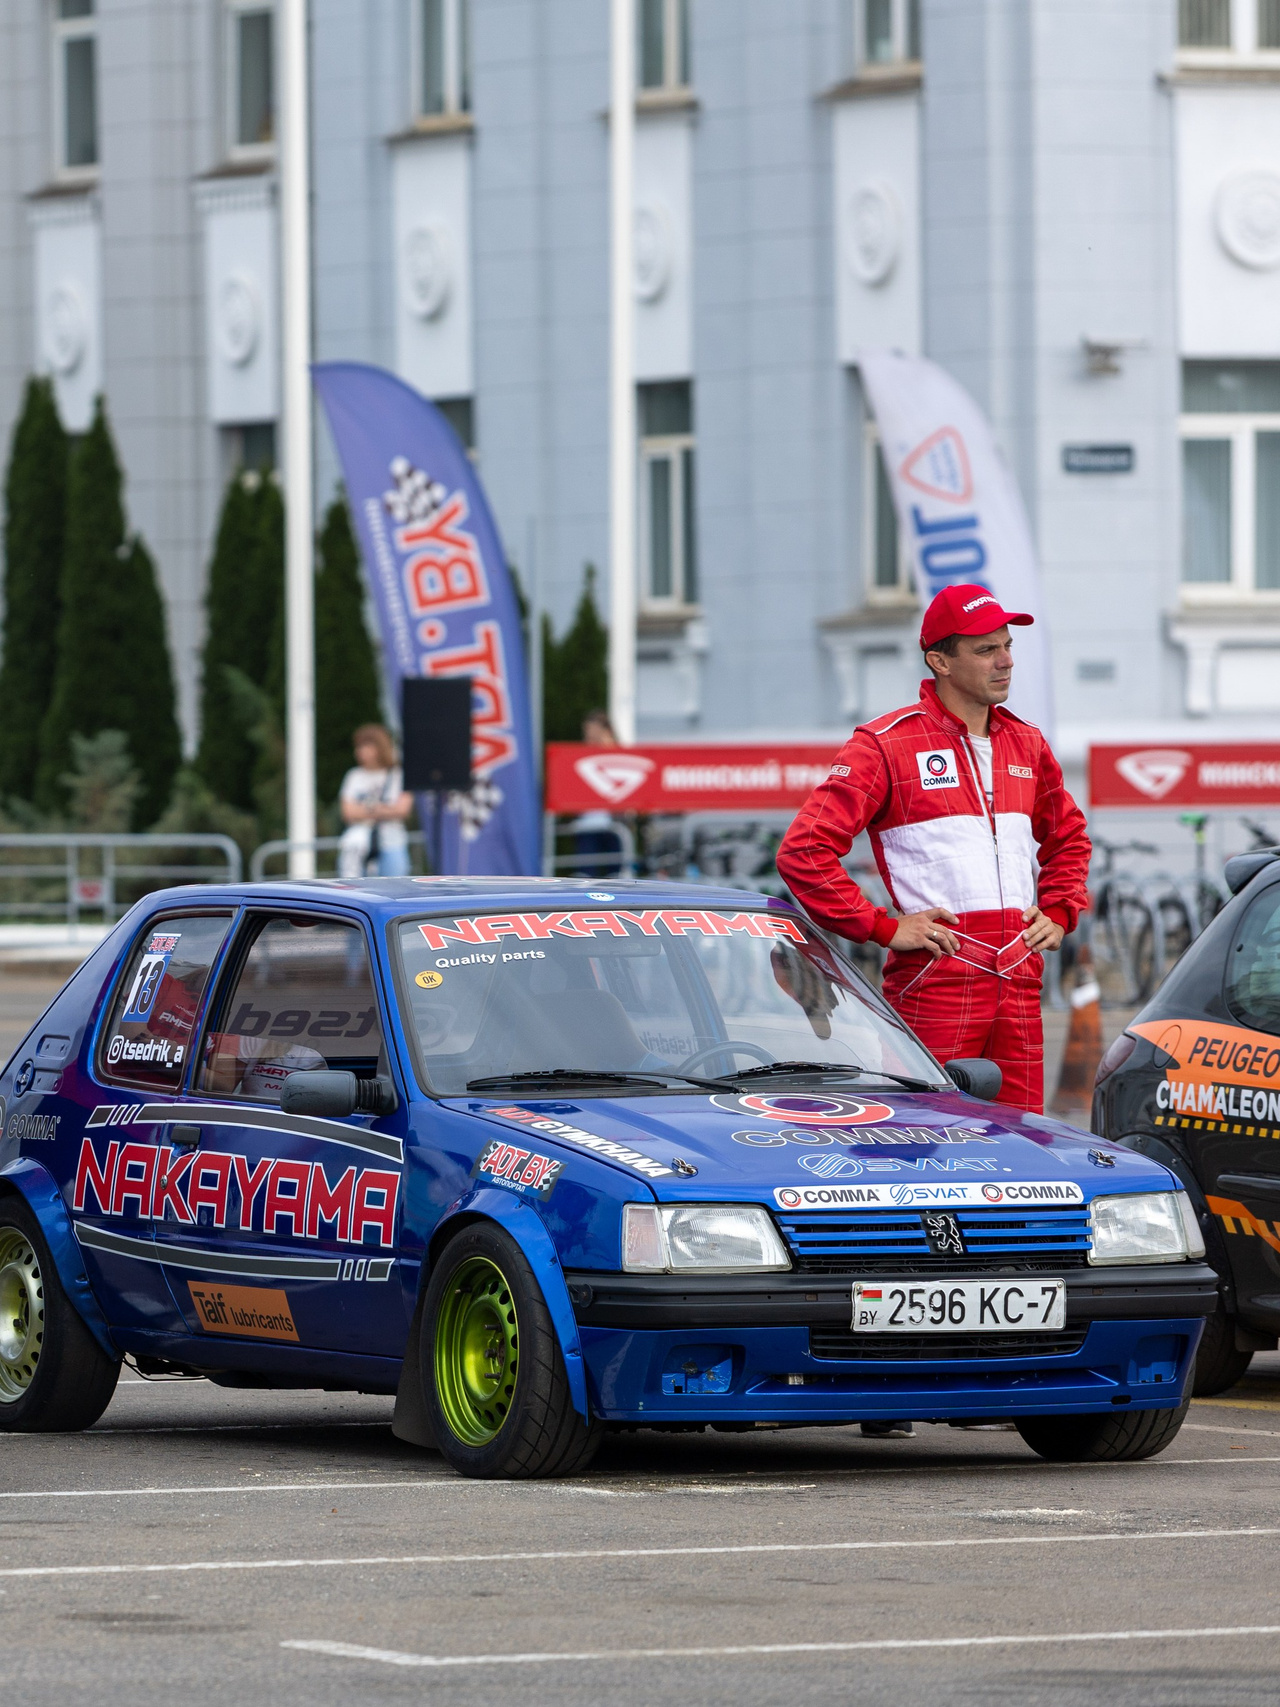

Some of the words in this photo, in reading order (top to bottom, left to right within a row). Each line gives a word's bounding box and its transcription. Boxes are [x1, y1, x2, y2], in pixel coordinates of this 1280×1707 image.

[923, 776, 956, 786] COMMA
[1011, 767, 1030, 776] RLG
[418, 910, 808, 950] NAKAYAMA
[435, 953, 496, 968] Quality
[502, 949, 546, 963] parts
[128, 960, 165, 1015] 13
[422, 975, 437, 984] OK
[122, 1039, 184, 1068] tsedrik_a
[480, 1143, 559, 1189] ADT.BY
[858, 1156, 999, 1172] SVIAT
[72, 1137, 402, 1248] NAKAYAMA
[491, 1176, 526, 1193] АВТОПОРТАЛ
[914, 1187, 969, 1200] SVIAT
[193, 1290, 229, 1325] Taif
[230, 1306, 294, 1333] lubricants
[888, 1287, 966, 1325] 2596
[979, 1286, 1058, 1325] KC-7
[859, 1310, 878, 1325] BY
